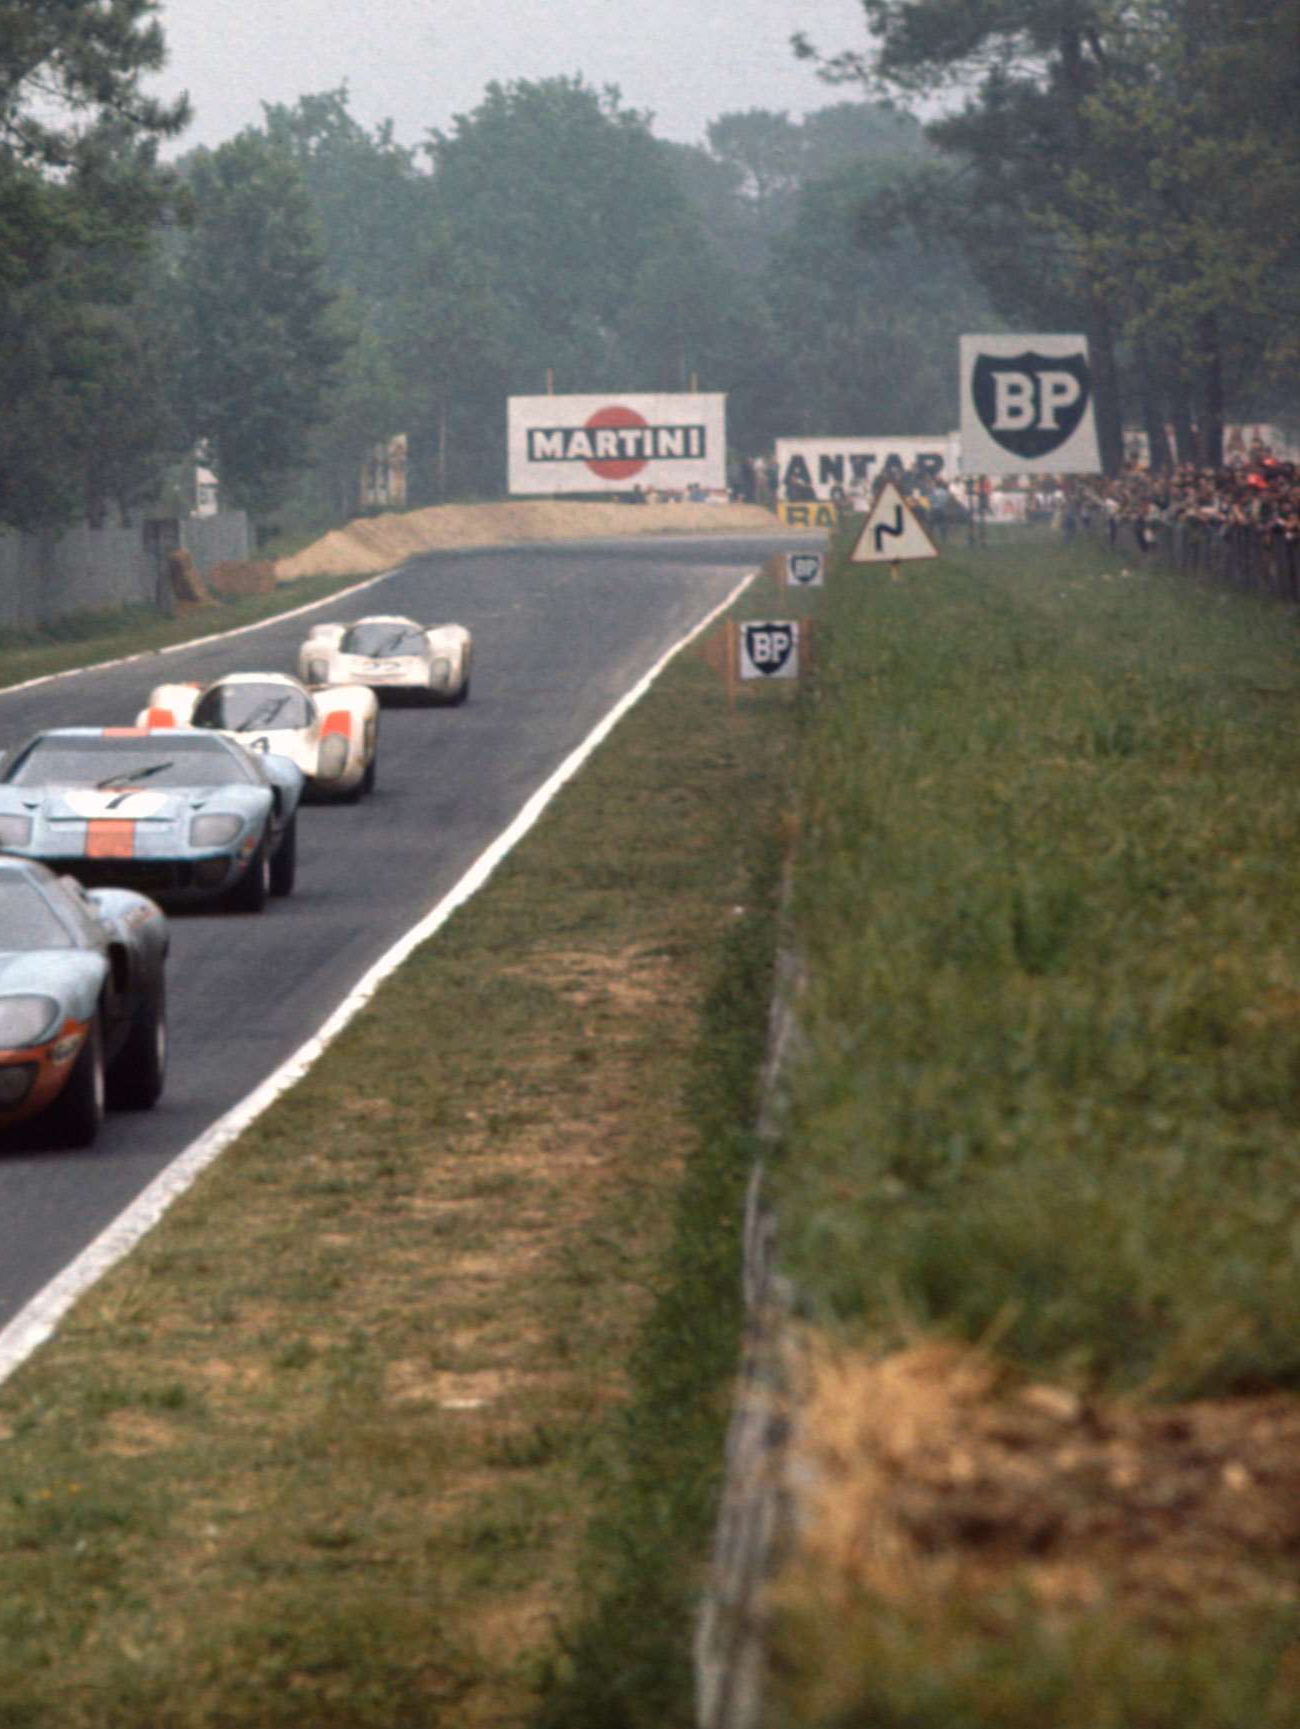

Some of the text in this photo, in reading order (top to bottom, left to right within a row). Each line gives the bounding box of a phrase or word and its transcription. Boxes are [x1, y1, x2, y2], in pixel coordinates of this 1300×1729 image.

[990, 371, 1081, 430] BP
[532, 428, 702, 459] MARTINI
[752, 630, 789, 663] BP
